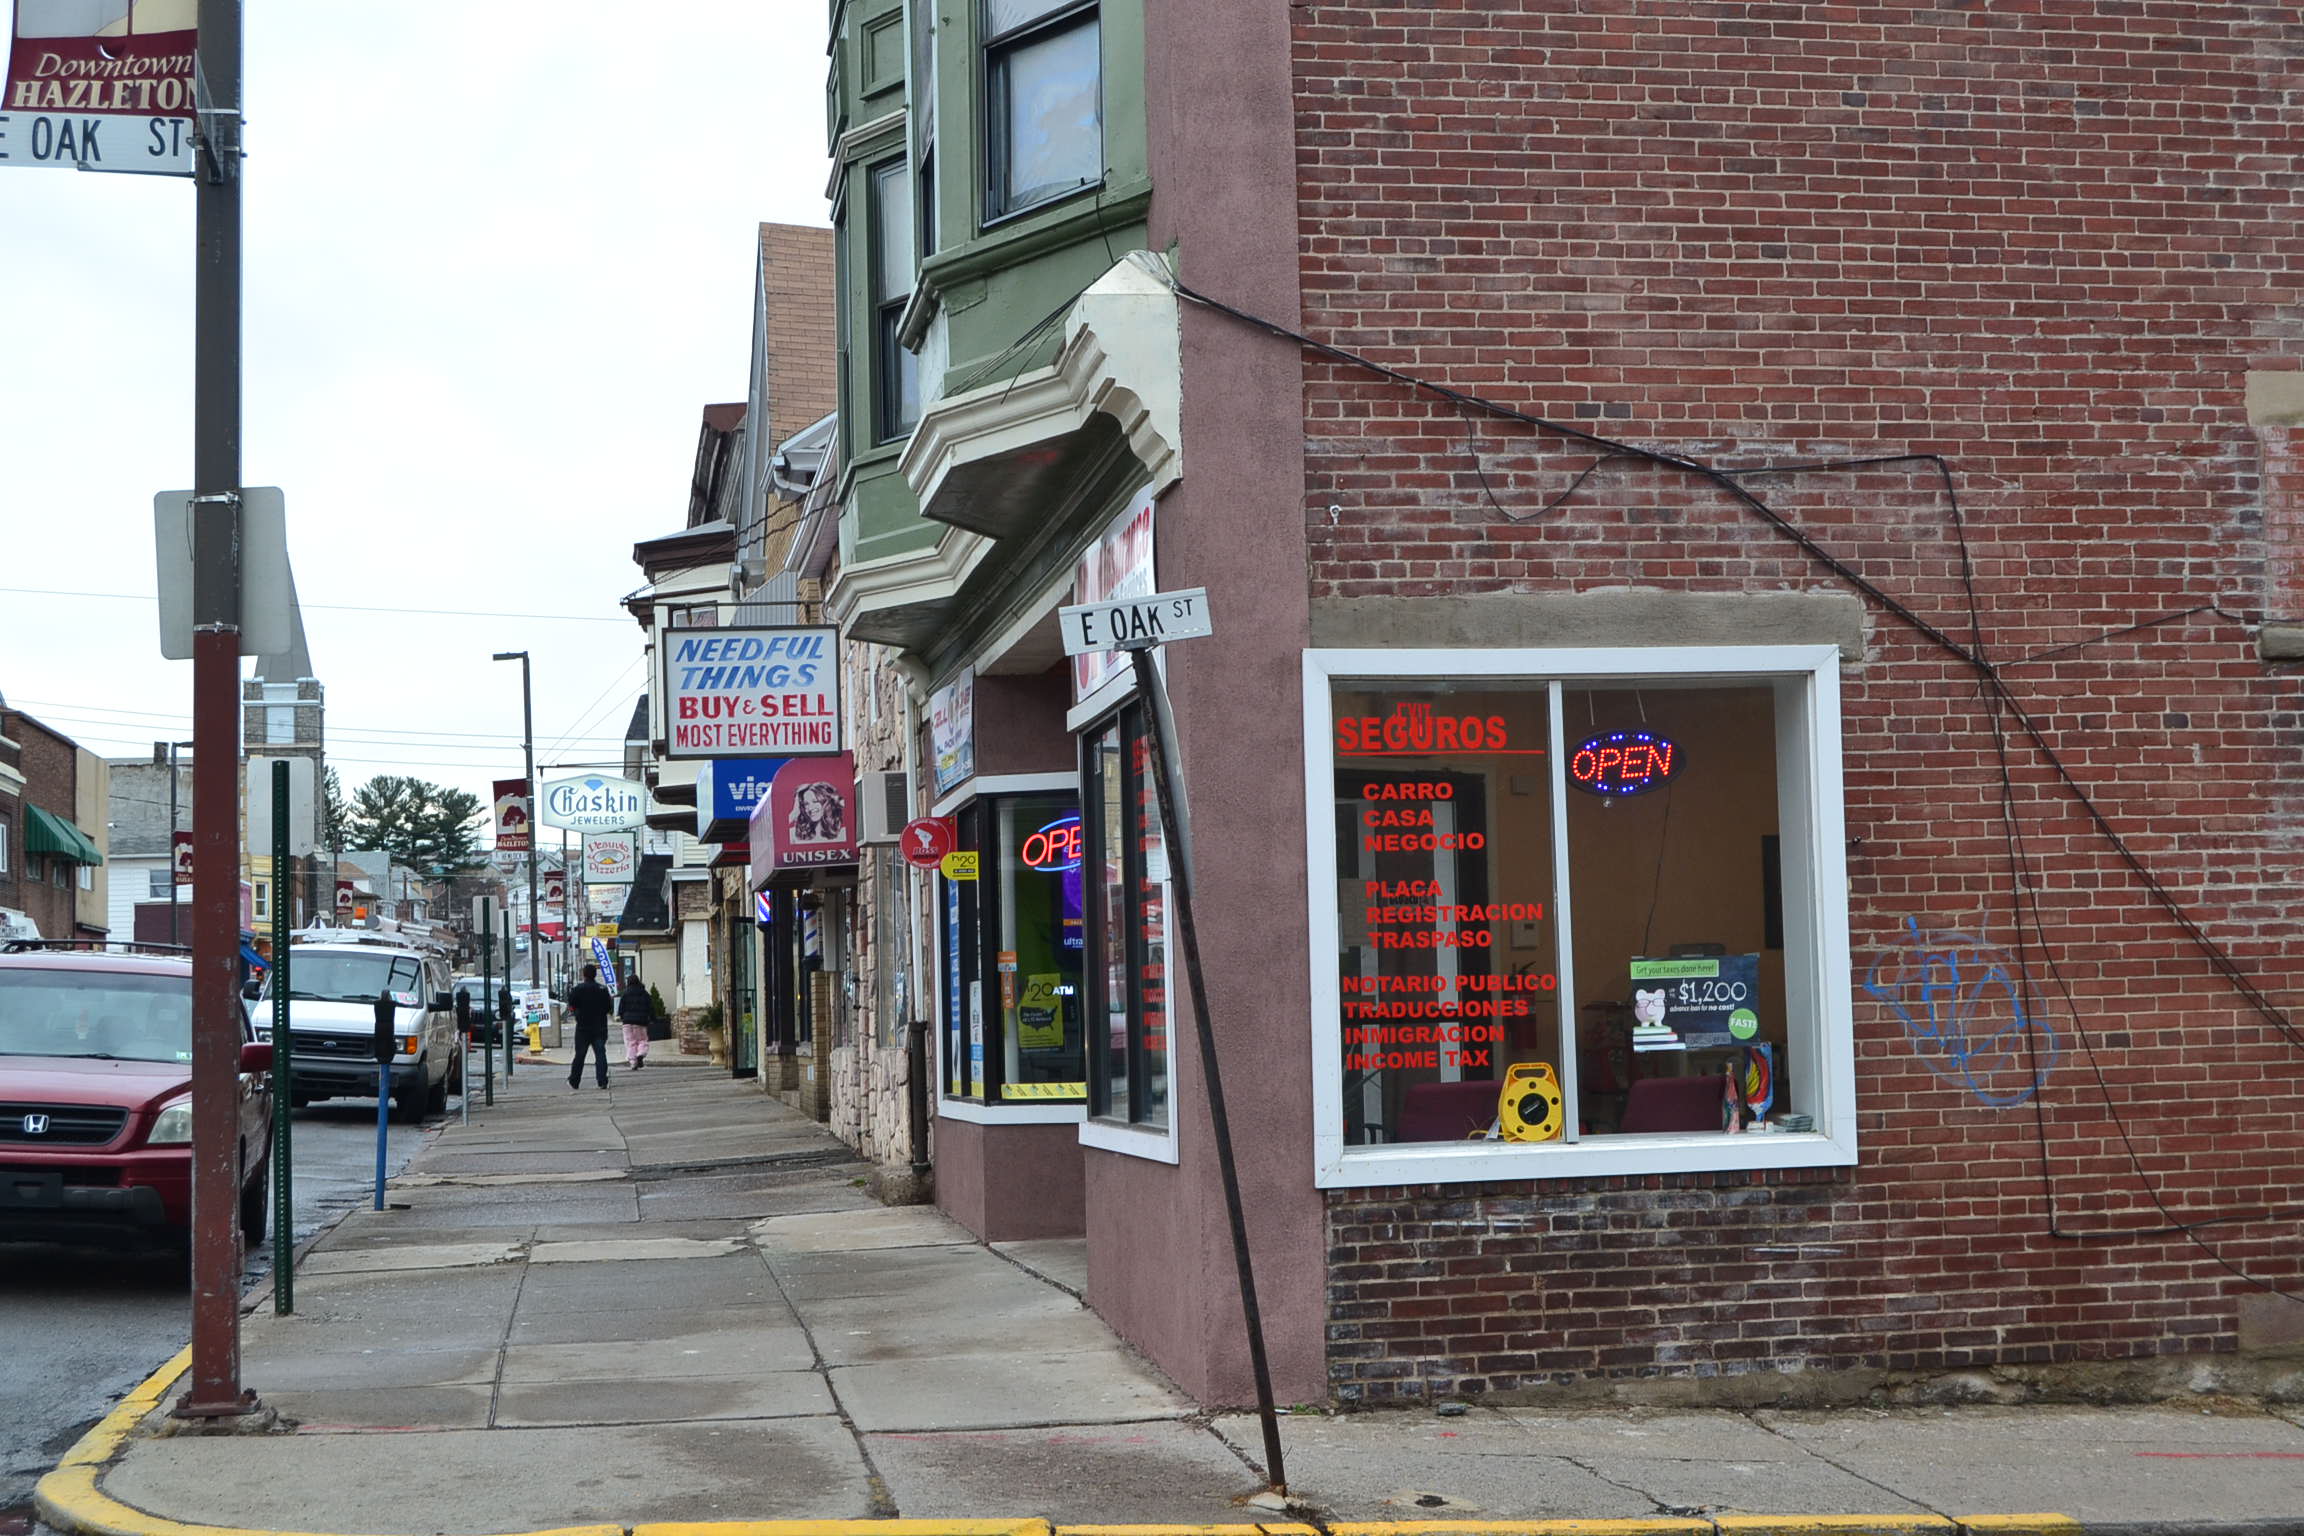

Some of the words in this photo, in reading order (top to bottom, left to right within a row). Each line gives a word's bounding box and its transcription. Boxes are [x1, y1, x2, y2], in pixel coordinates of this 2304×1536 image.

[35, 53, 192, 77] Downtown
[32, 117, 102, 161] OAK
[148, 117, 184, 157] ST
[1081, 612, 1097, 646] E
[1110, 605, 1165, 641] OAK
[1173, 599, 1193, 618] ST
[675, 636, 824, 662] NEEDFUL
[680, 663, 818, 690] THINGS
[676, 724, 723, 748] MOST
[728, 721, 832, 747] EVERYTHING
[1337, 715, 1508, 750] SEGUROS
[1572, 743, 1672, 780] OPEN
[1363, 782, 1454, 800] CARRO
[550, 785, 638, 817] Chaskin
[570, 816, 625, 825] JEWELERS
[1363, 809, 1434, 827] CASA
[1364, 832, 1485, 851] NEGOCIO
[783, 849, 851, 863] UNISEX
[589, 863, 630, 874] Pizzeria
[1365, 880, 1443, 898] PLACA
[1366, 903, 1543, 924] REGISTRACION
[1368, 930, 1492, 948] TRASPASO
[1680, 965, 1697, 973] done
[1052, 985, 1074, 995] ATM
[1343, 975, 1447, 993] NOTARIO
[1454, 974, 1556, 991] PUBLICO
[1679, 978, 1747, 1004] $1,200
[1344, 1000, 1529, 1018] TRADUCCIONES
[1345, 1026, 1505, 1045] INMIGRACION
[1346, 1050, 1438, 1070] INCOME
[1445, 1050, 1489, 1067] TAX
